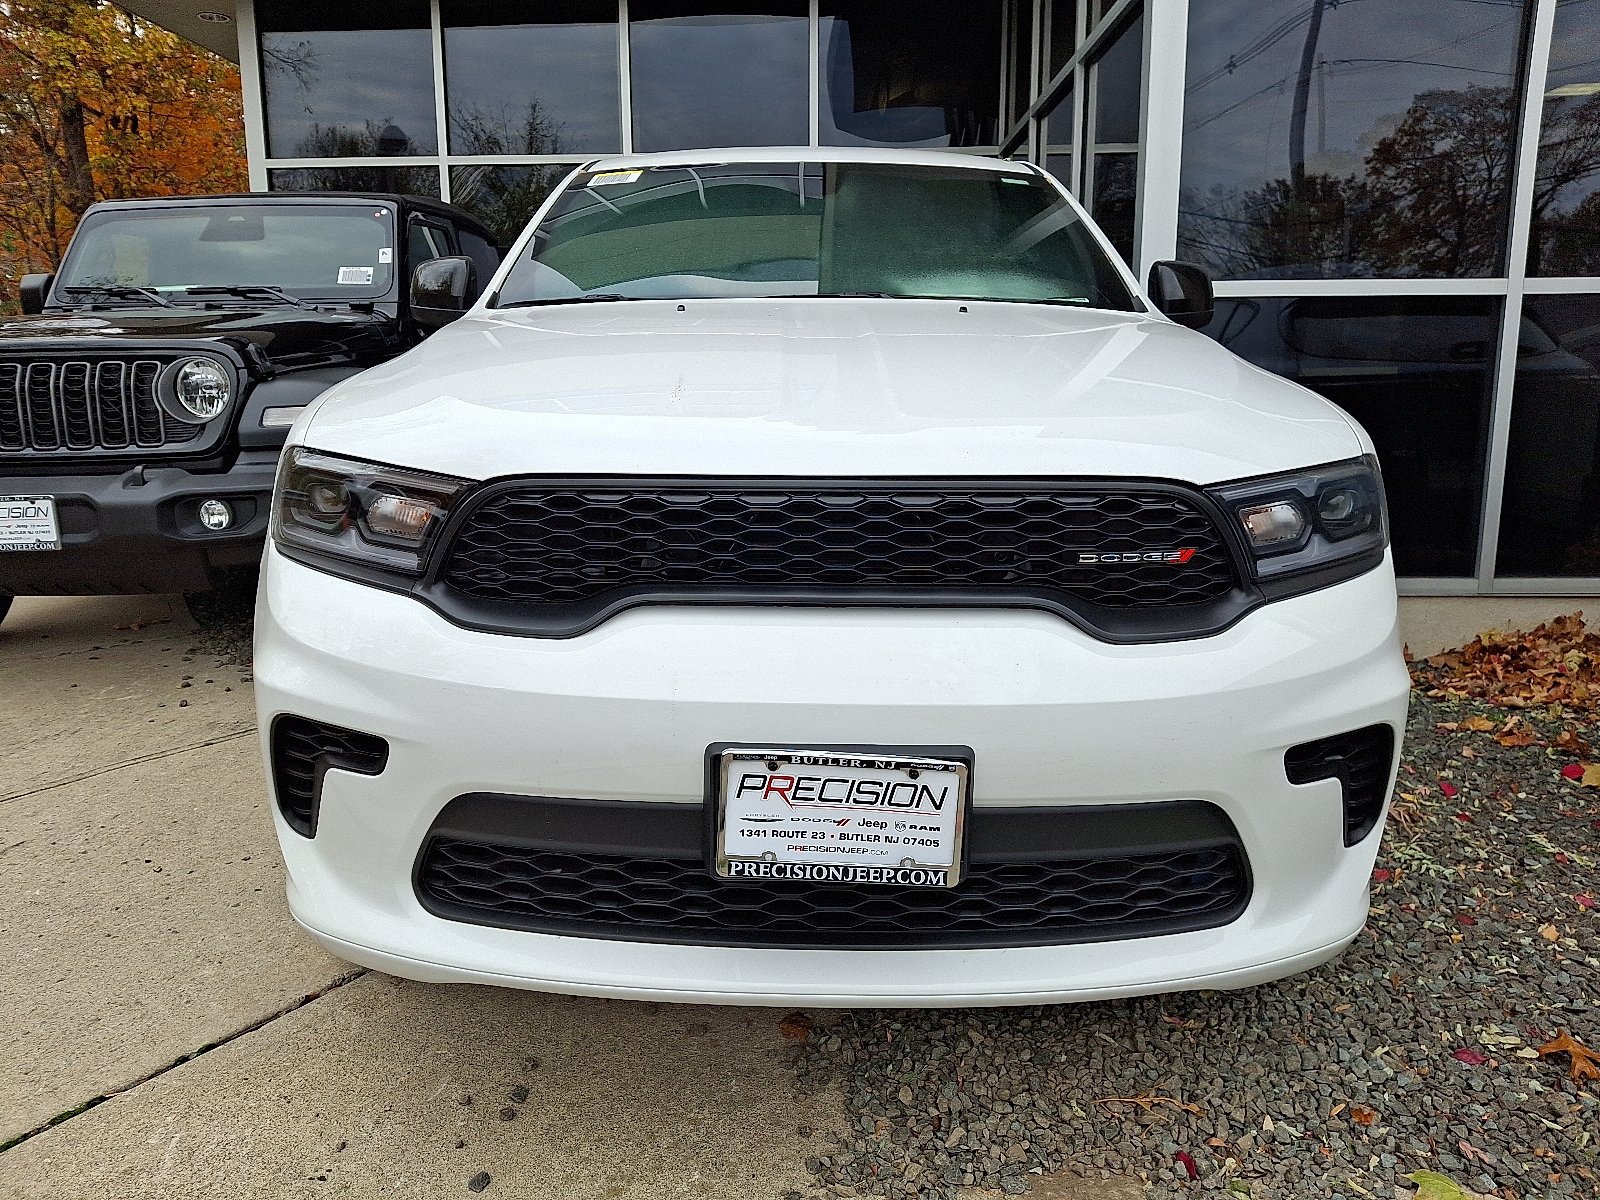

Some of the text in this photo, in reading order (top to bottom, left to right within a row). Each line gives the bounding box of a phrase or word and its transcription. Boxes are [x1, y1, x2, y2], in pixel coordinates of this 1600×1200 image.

[1079, 552, 1181, 563] DODGE
[790, 755, 867, 768] BUTLER,
[874, 760, 897, 769] NJ
[735, 773, 949, 811] PRECISION
[857, 817, 888, 830] Jeep
[909, 824, 941, 832] RAM
[739, 829, 940, 848] 1341 ROUTE 23 BUTLER NJ 07405
[728, 861, 946, 886] PRECISIONJEEP.COM
